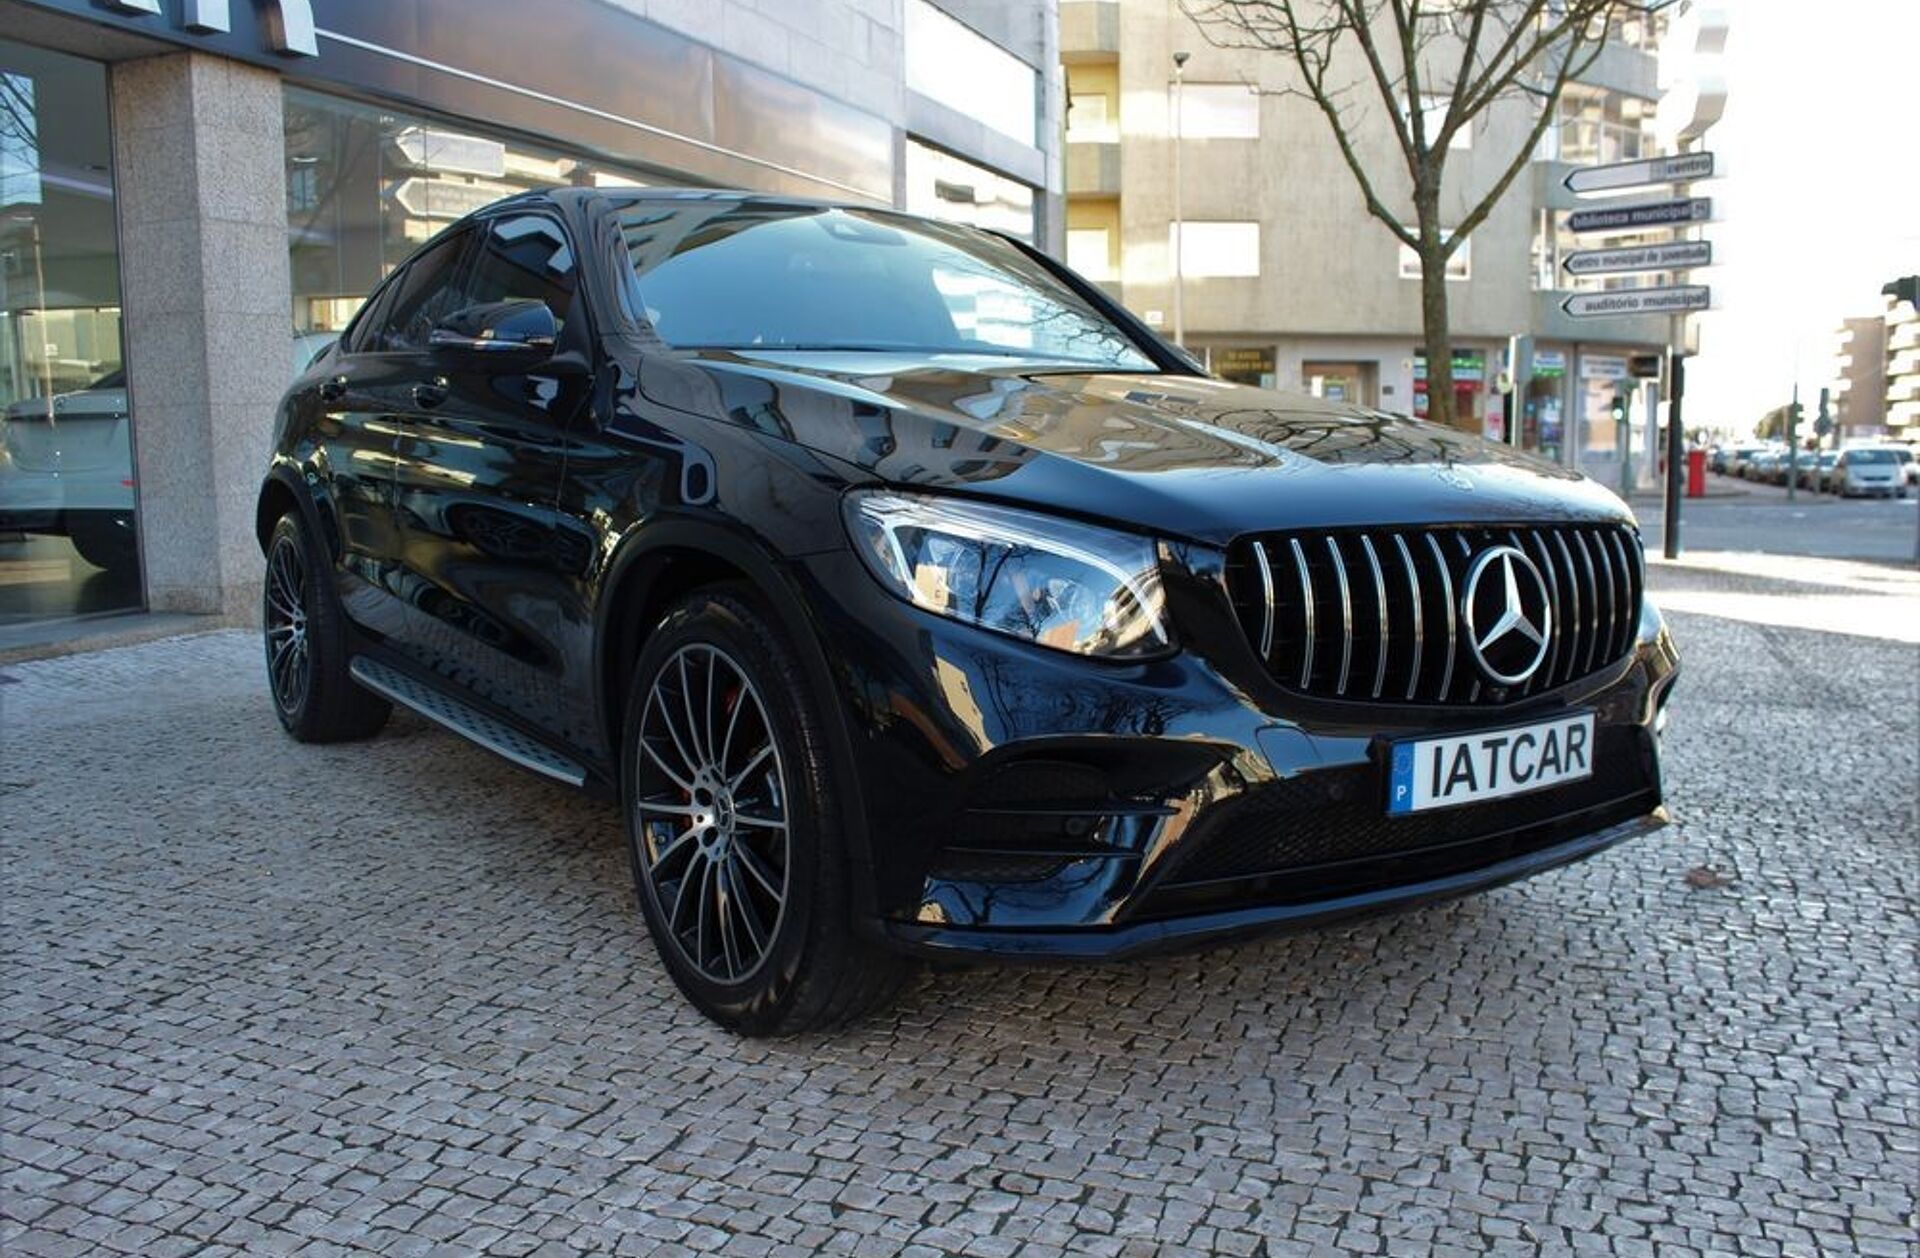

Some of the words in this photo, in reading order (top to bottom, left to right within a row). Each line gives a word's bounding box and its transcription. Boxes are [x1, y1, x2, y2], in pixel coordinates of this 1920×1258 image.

[1632, 204, 1690, 221] municipal
[1585, 296, 1639, 312] auditório
[1643, 292, 1708, 310] municipal
[1397, 785, 1407, 800] P
[1432, 722, 1586, 798] IATCAR
